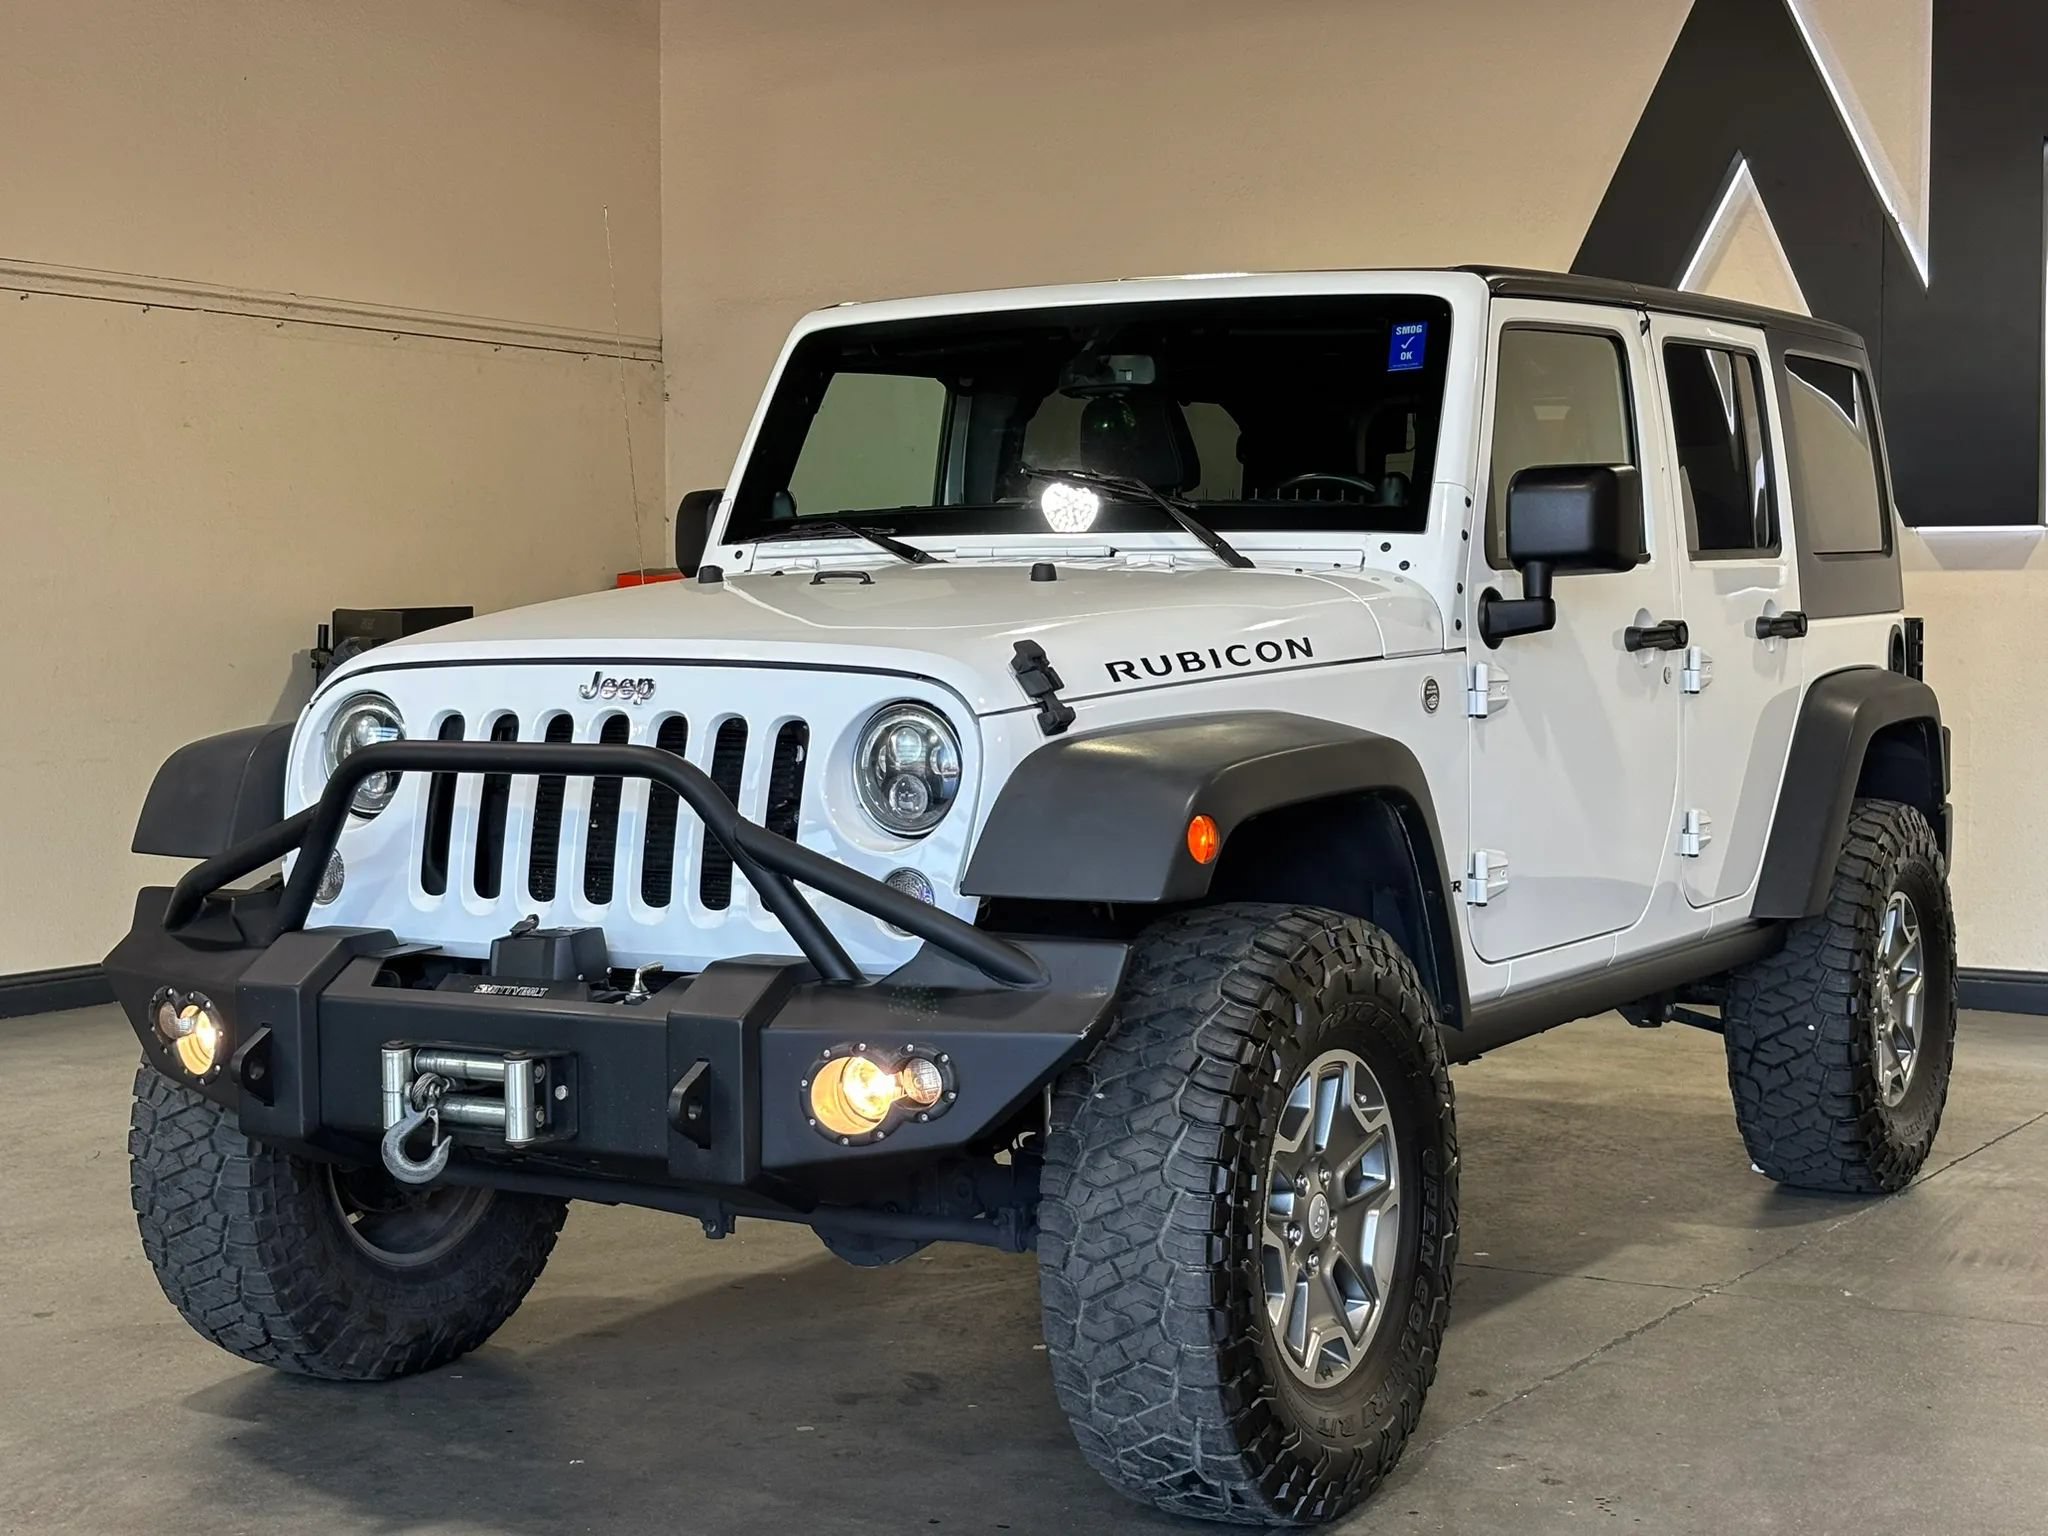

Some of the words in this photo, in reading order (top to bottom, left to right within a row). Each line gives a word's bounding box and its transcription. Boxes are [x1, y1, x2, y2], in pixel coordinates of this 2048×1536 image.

[1395, 324, 1423, 336] SMOG
[1400, 350, 1414, 360] OK
[1104, 637, 1314, 683] RUBICON
[579, 671, 656, 705] Jeep
[1418, 1147, 1438, 1270] OPEN
